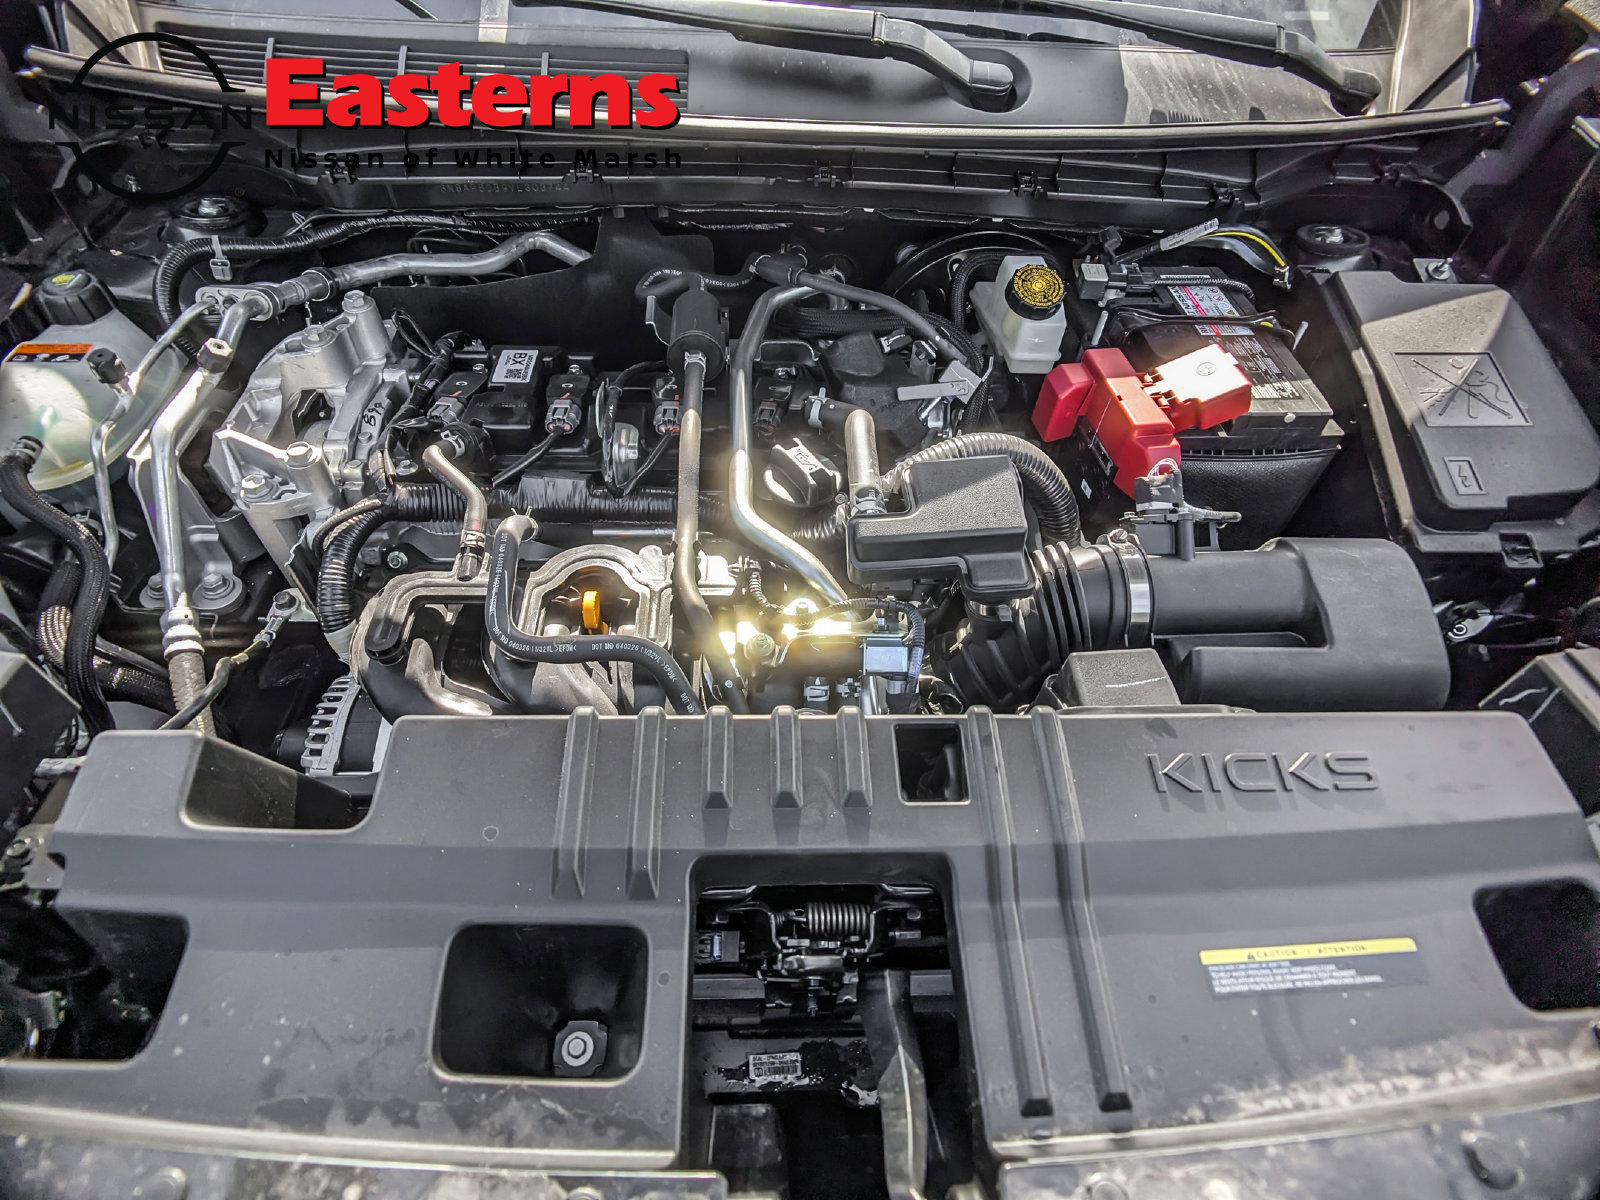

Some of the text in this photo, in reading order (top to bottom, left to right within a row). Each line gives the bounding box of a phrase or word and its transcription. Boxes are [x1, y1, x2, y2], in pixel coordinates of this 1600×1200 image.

[509, 352, 528, 366] BX
[1145, 752, 1379, 793] KICKS
[1255, 949, 1298, 960] CAUTION
[1318, 945, 1368, 955] ATTENTION
